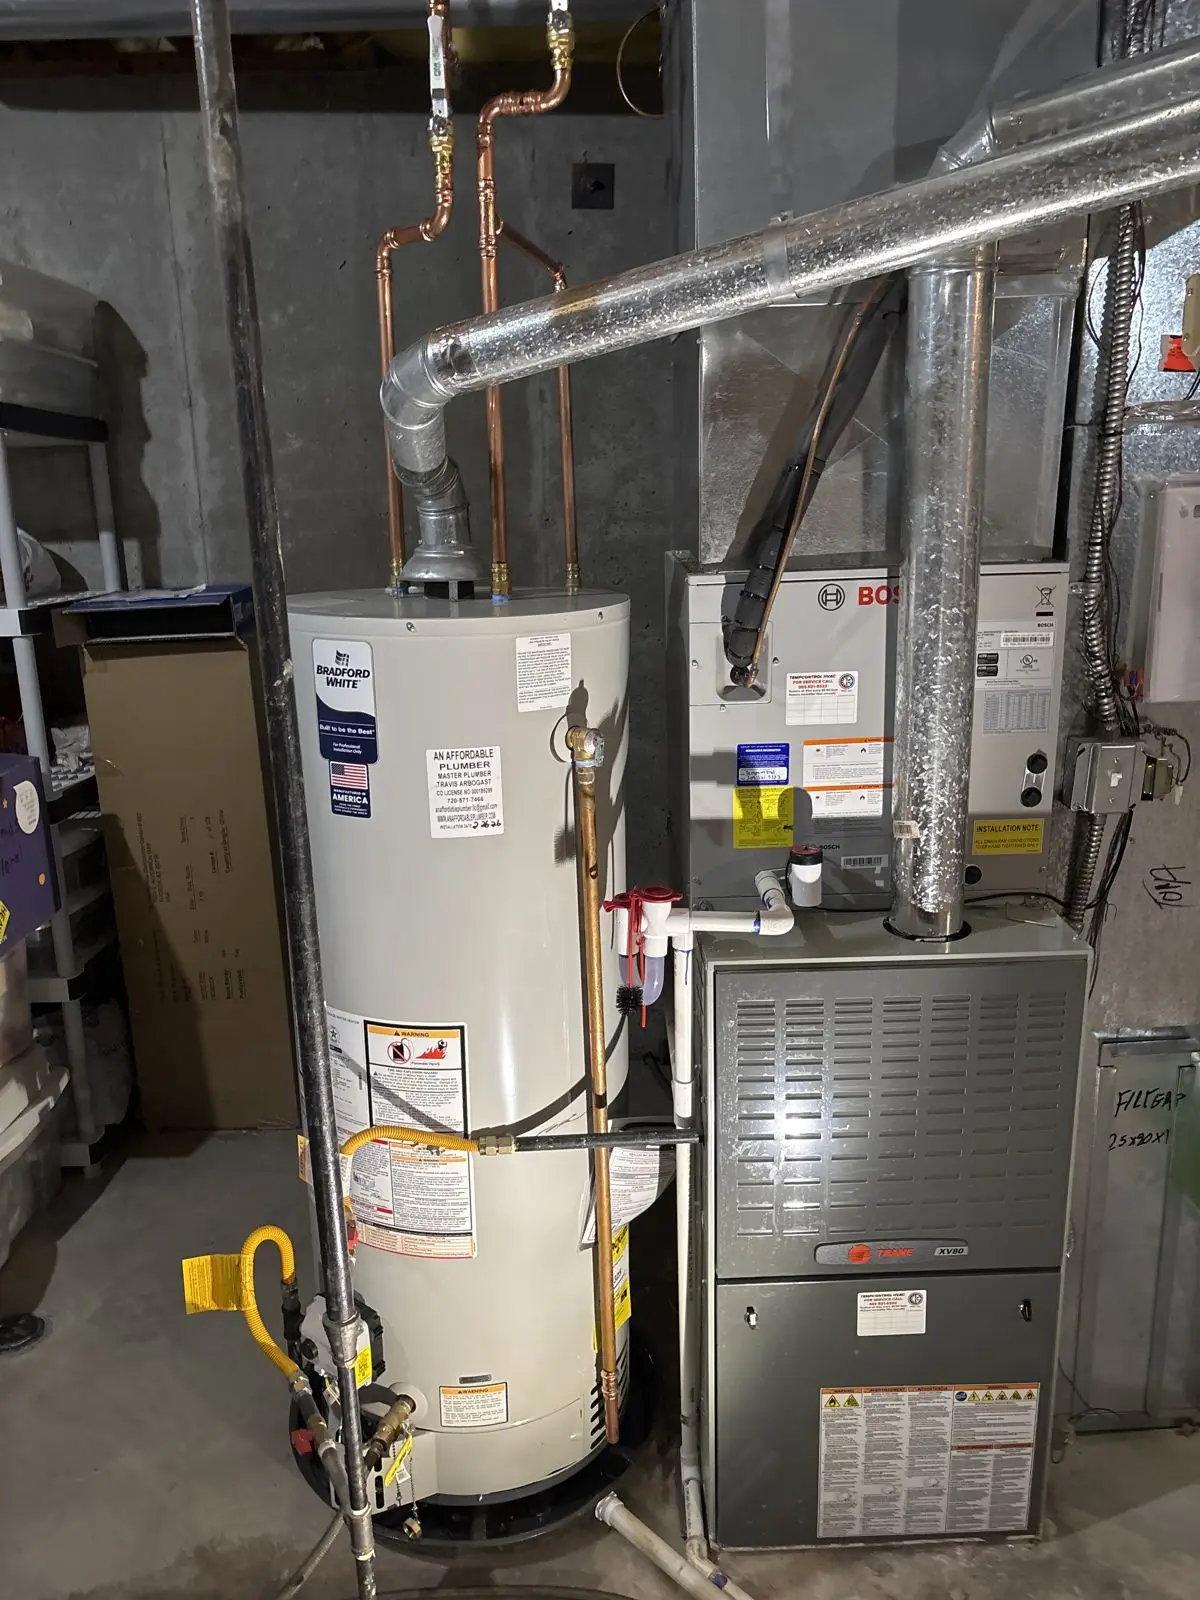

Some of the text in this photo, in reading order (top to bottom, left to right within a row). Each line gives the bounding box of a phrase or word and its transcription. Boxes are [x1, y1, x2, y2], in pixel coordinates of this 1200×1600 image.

[316, 664, 371, 679] BRADFORD
[326, 676, 359, 689] WHITE
[433, 748, 494, 761] AN AFFORDABLE
[439, 761, 491, 771] PLUMBER
[437, 770, 492, 780] MASTER PLUMBER
[459, 778, 492, 787] ARBOGAST
[332, 793, 369, 805] AMERICA
[976, 823, 1040, 833] INSTALLATION NOTE
[938, 1247, 965, 1256] XV80
[462, 1387, 489, 1395] WARNING
